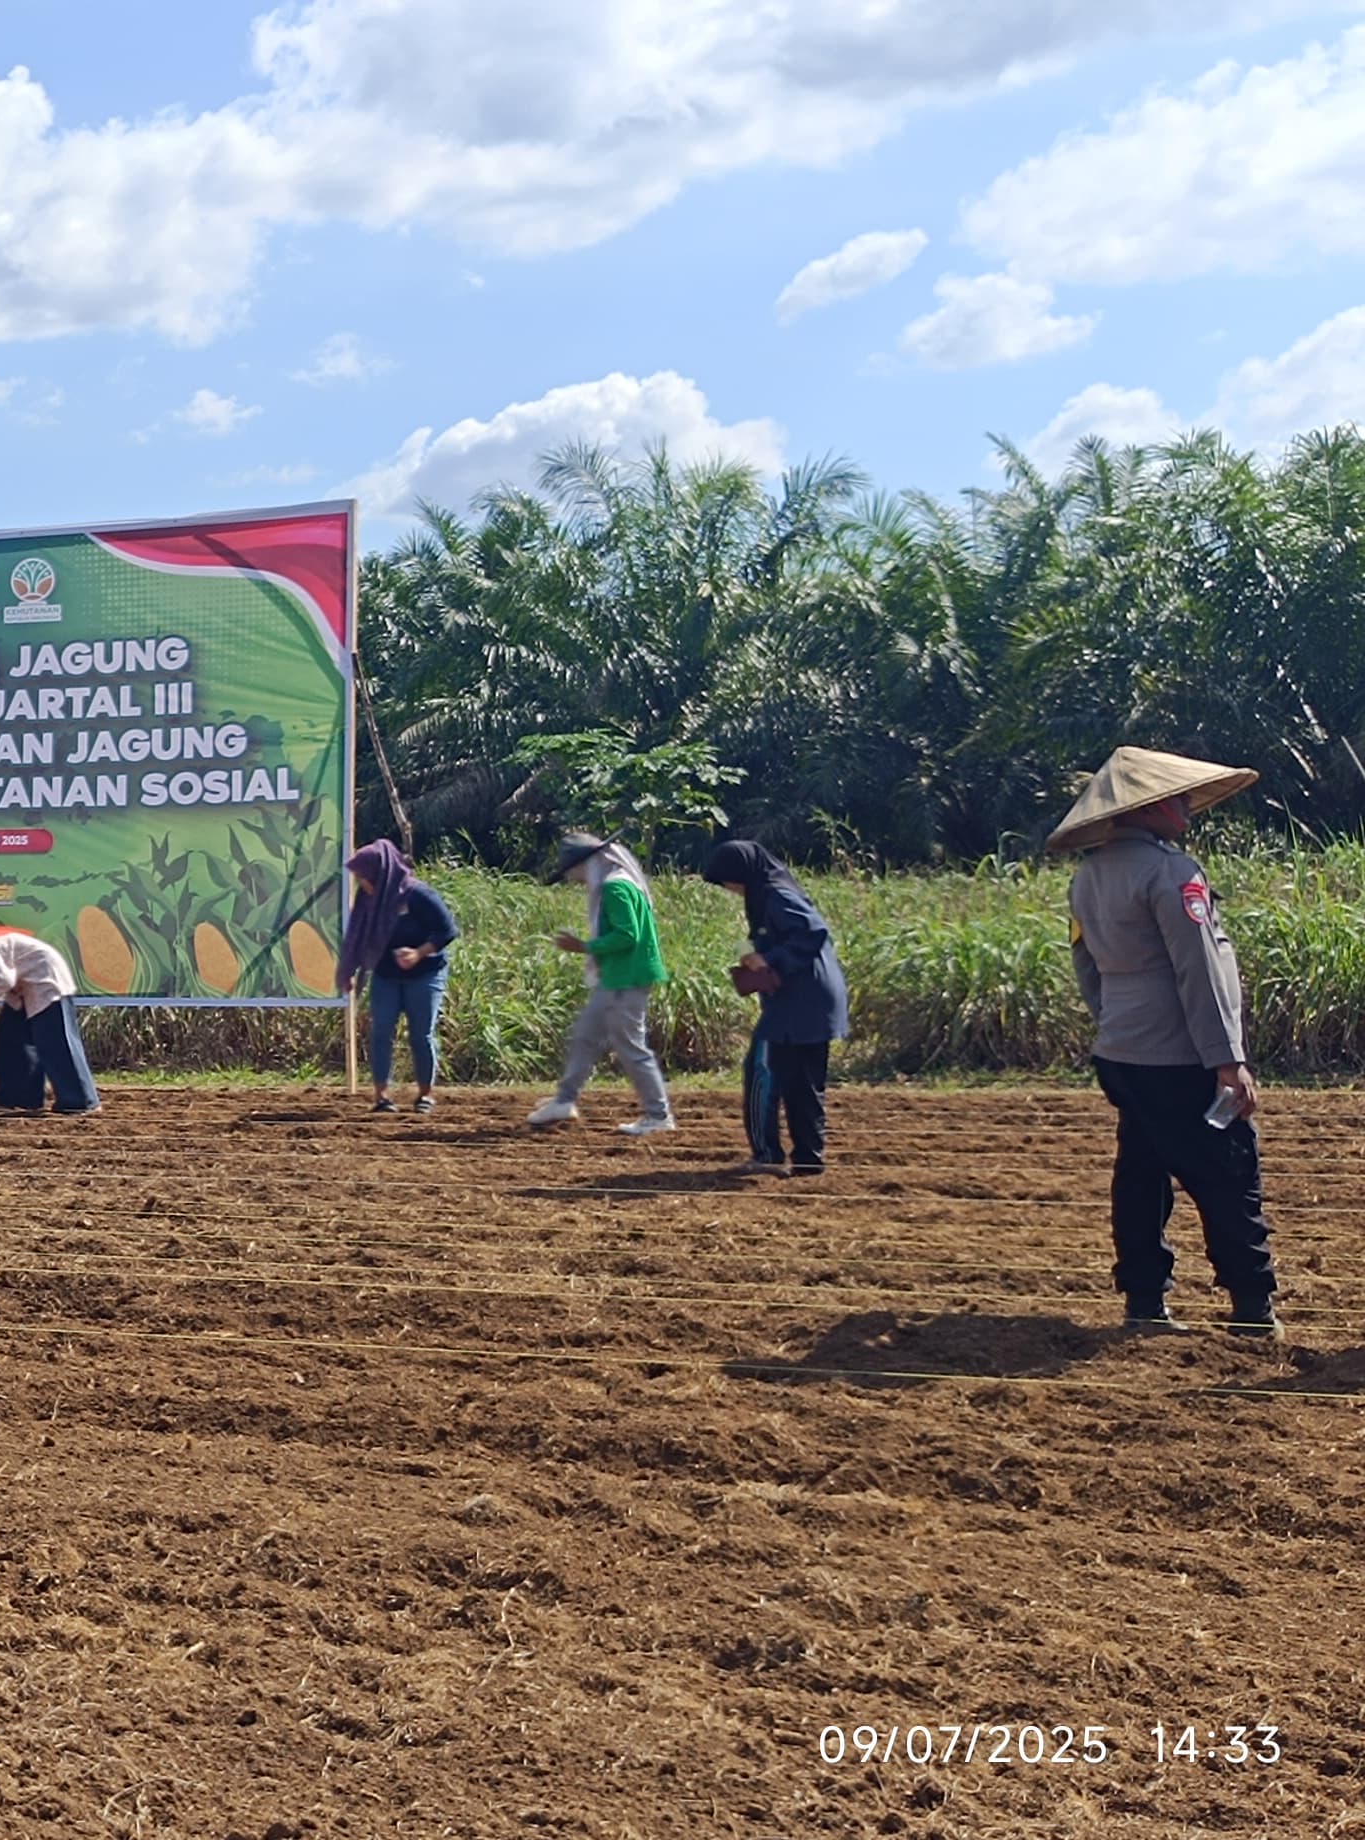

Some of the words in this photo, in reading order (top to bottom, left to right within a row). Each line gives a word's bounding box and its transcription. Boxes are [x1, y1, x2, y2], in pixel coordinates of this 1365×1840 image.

[9, 637, 189, 678] JAGUNG
[154, 682, 193, 715] III
[67, 724, 248, 764] JAGUNG
[140, 767, 300, 806] SOSIAL
[2, 835, 29, 846] 2025
